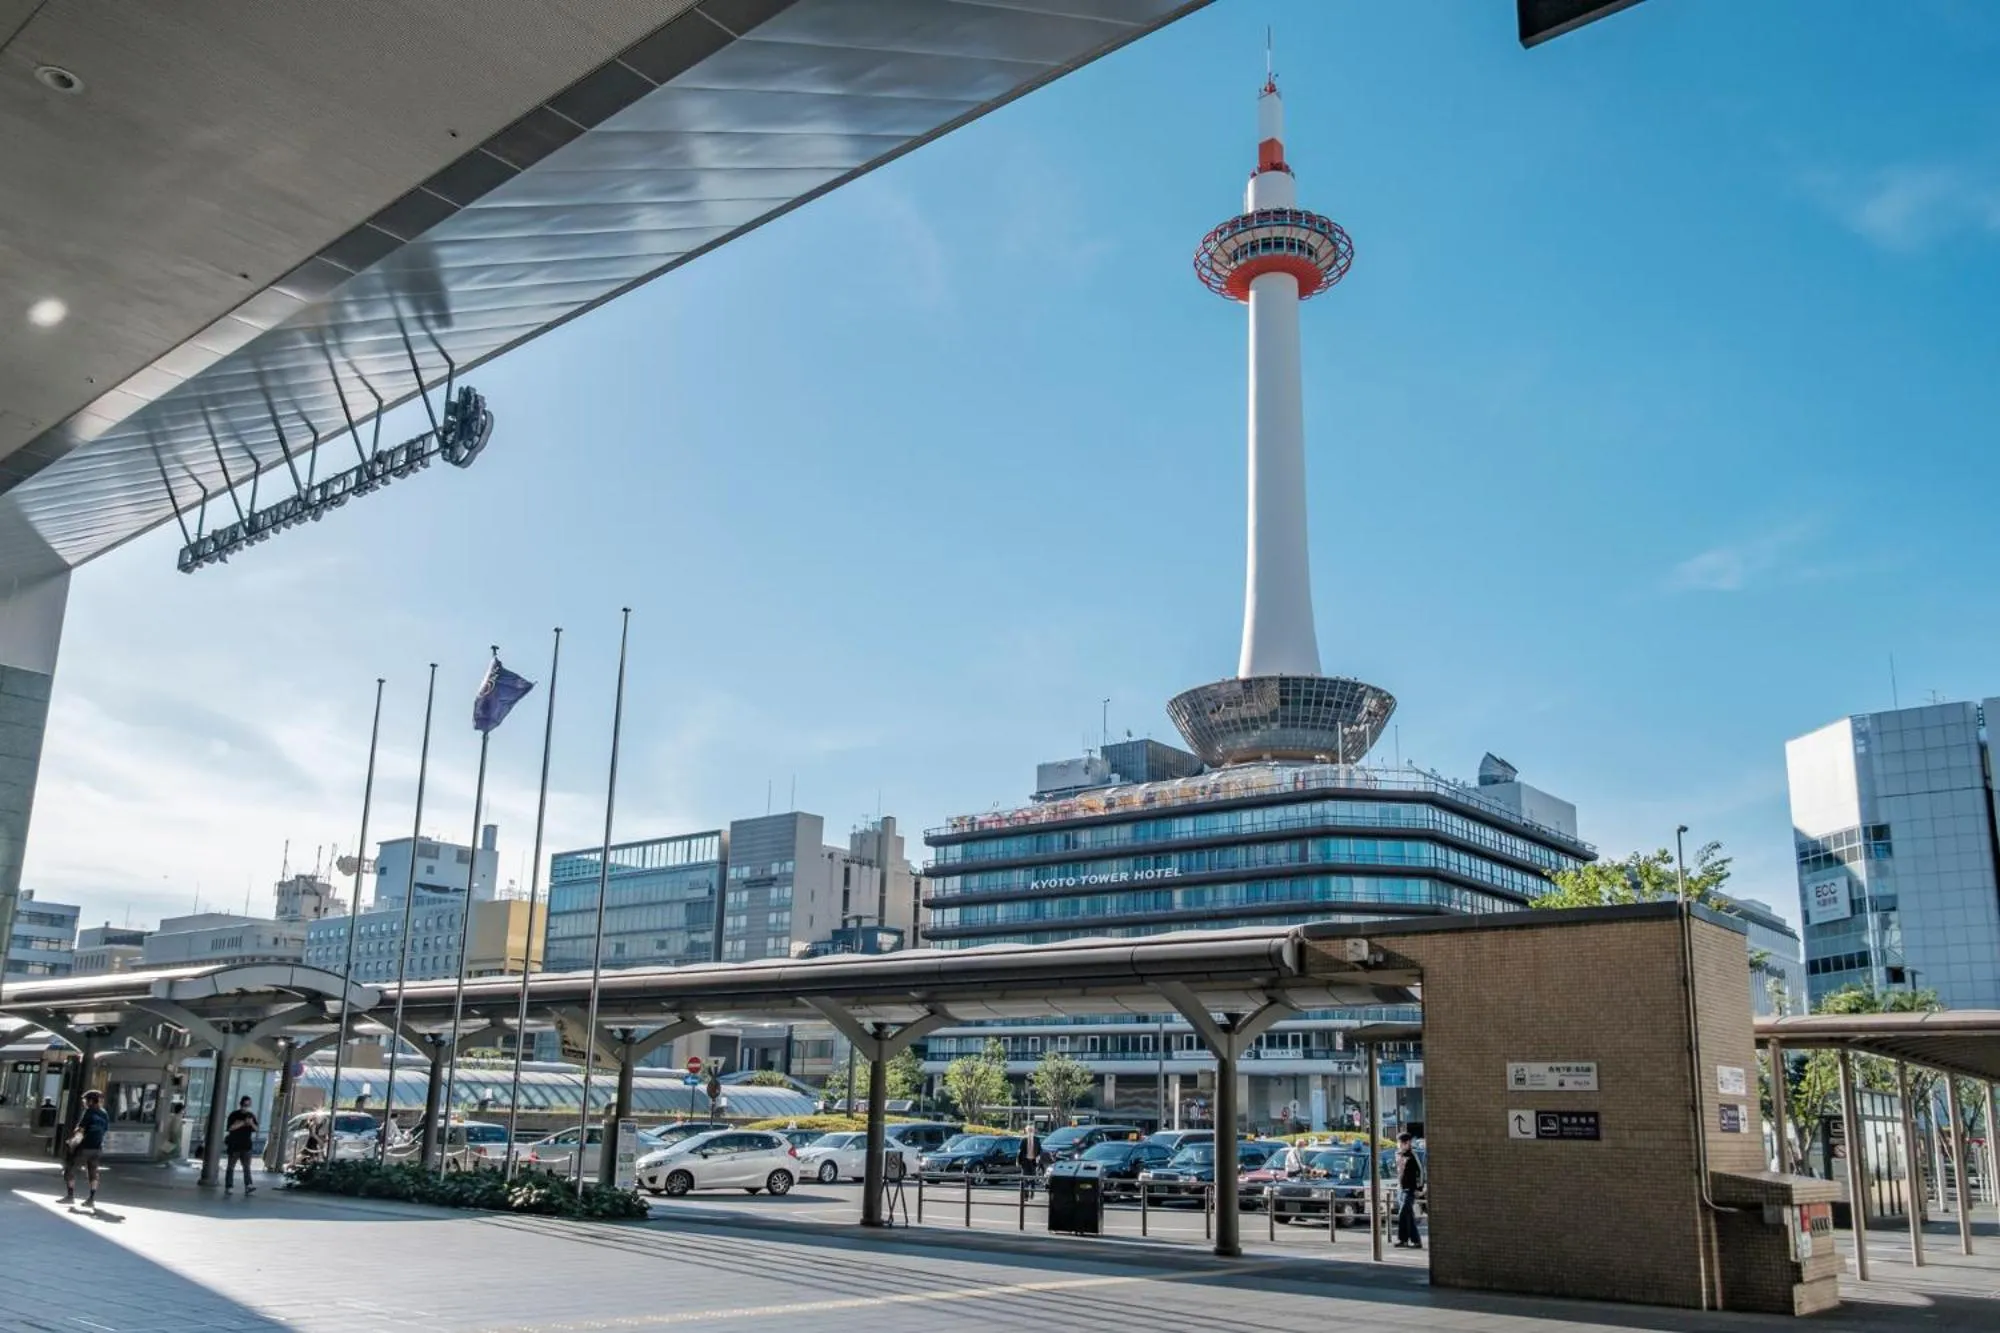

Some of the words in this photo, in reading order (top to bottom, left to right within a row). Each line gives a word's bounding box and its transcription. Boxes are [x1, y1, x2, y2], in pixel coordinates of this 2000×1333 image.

[1030, 876, 1076, 890] KYOTO
[1080, 871, 1129, 885] TOWER
[1134, 867, 1182, 881] HOTEL
[1815, 882, 1837, 898] ECC
